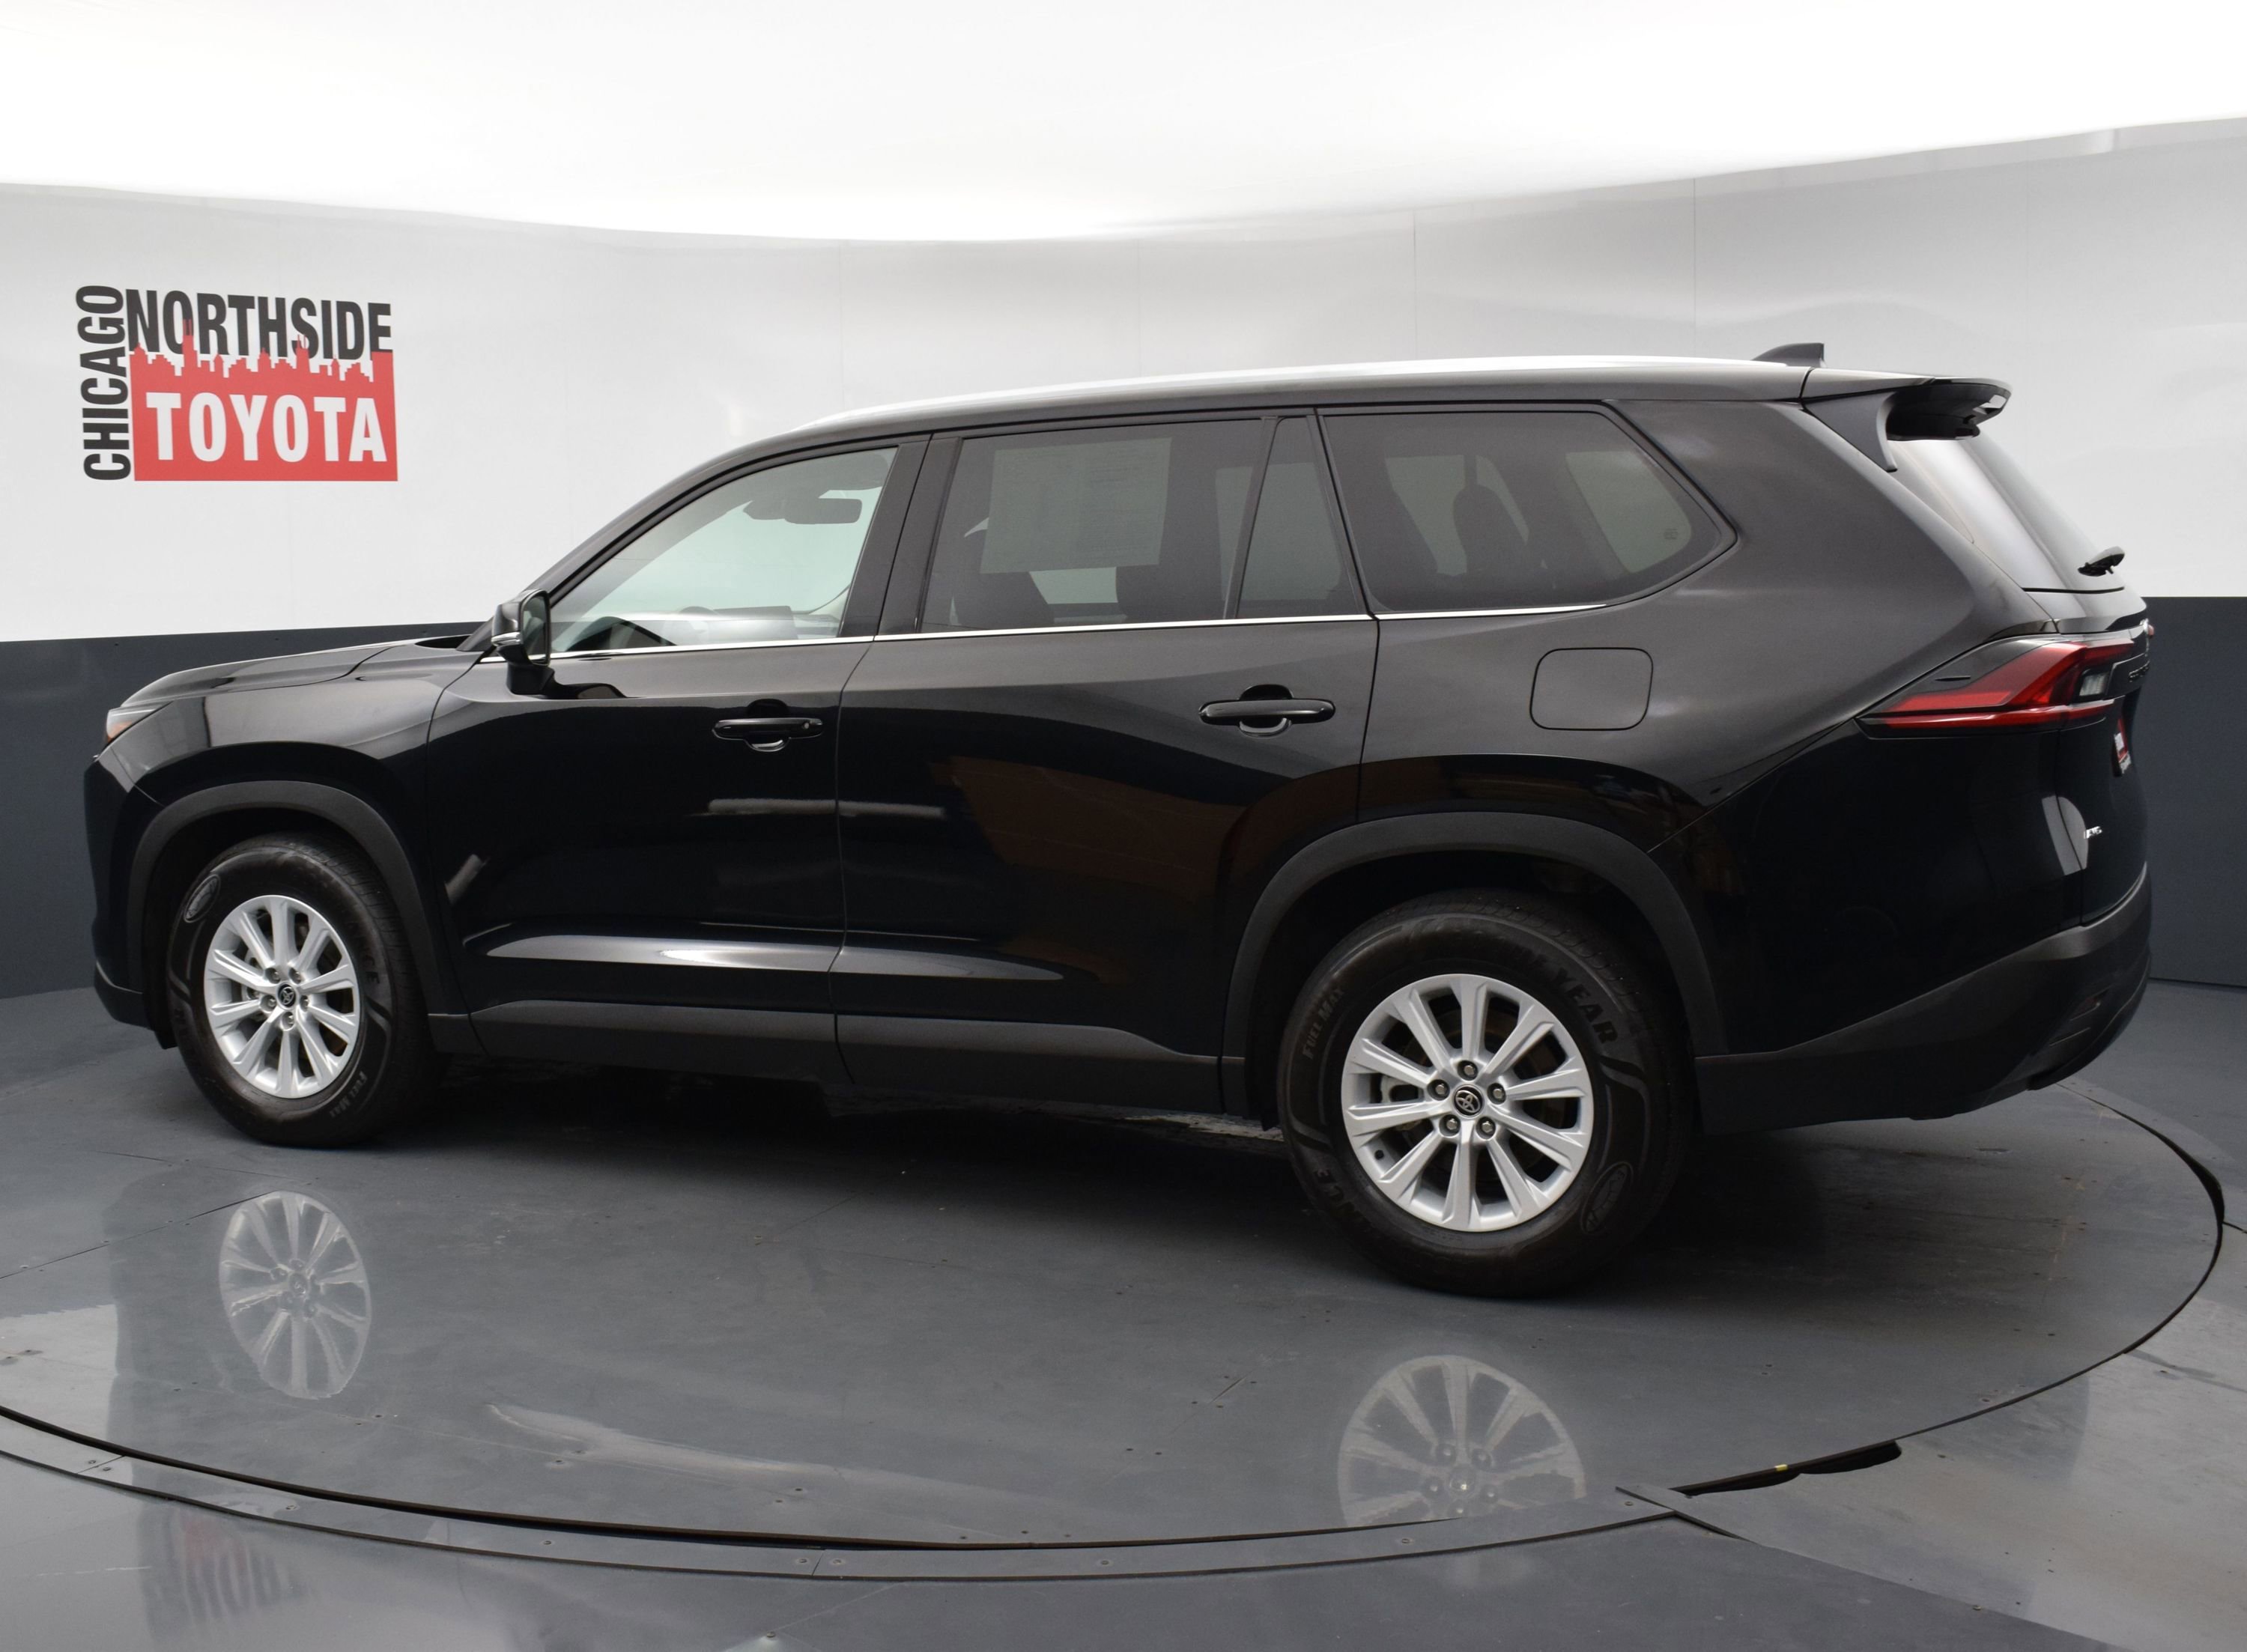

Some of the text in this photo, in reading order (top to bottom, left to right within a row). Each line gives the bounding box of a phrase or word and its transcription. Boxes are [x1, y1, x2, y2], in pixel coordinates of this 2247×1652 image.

[126, 289, 392, 360] NORTHSIDE
[76, 285, 131, 480] CHICAGO
[146, 392, 387, 462] TOYOTA
